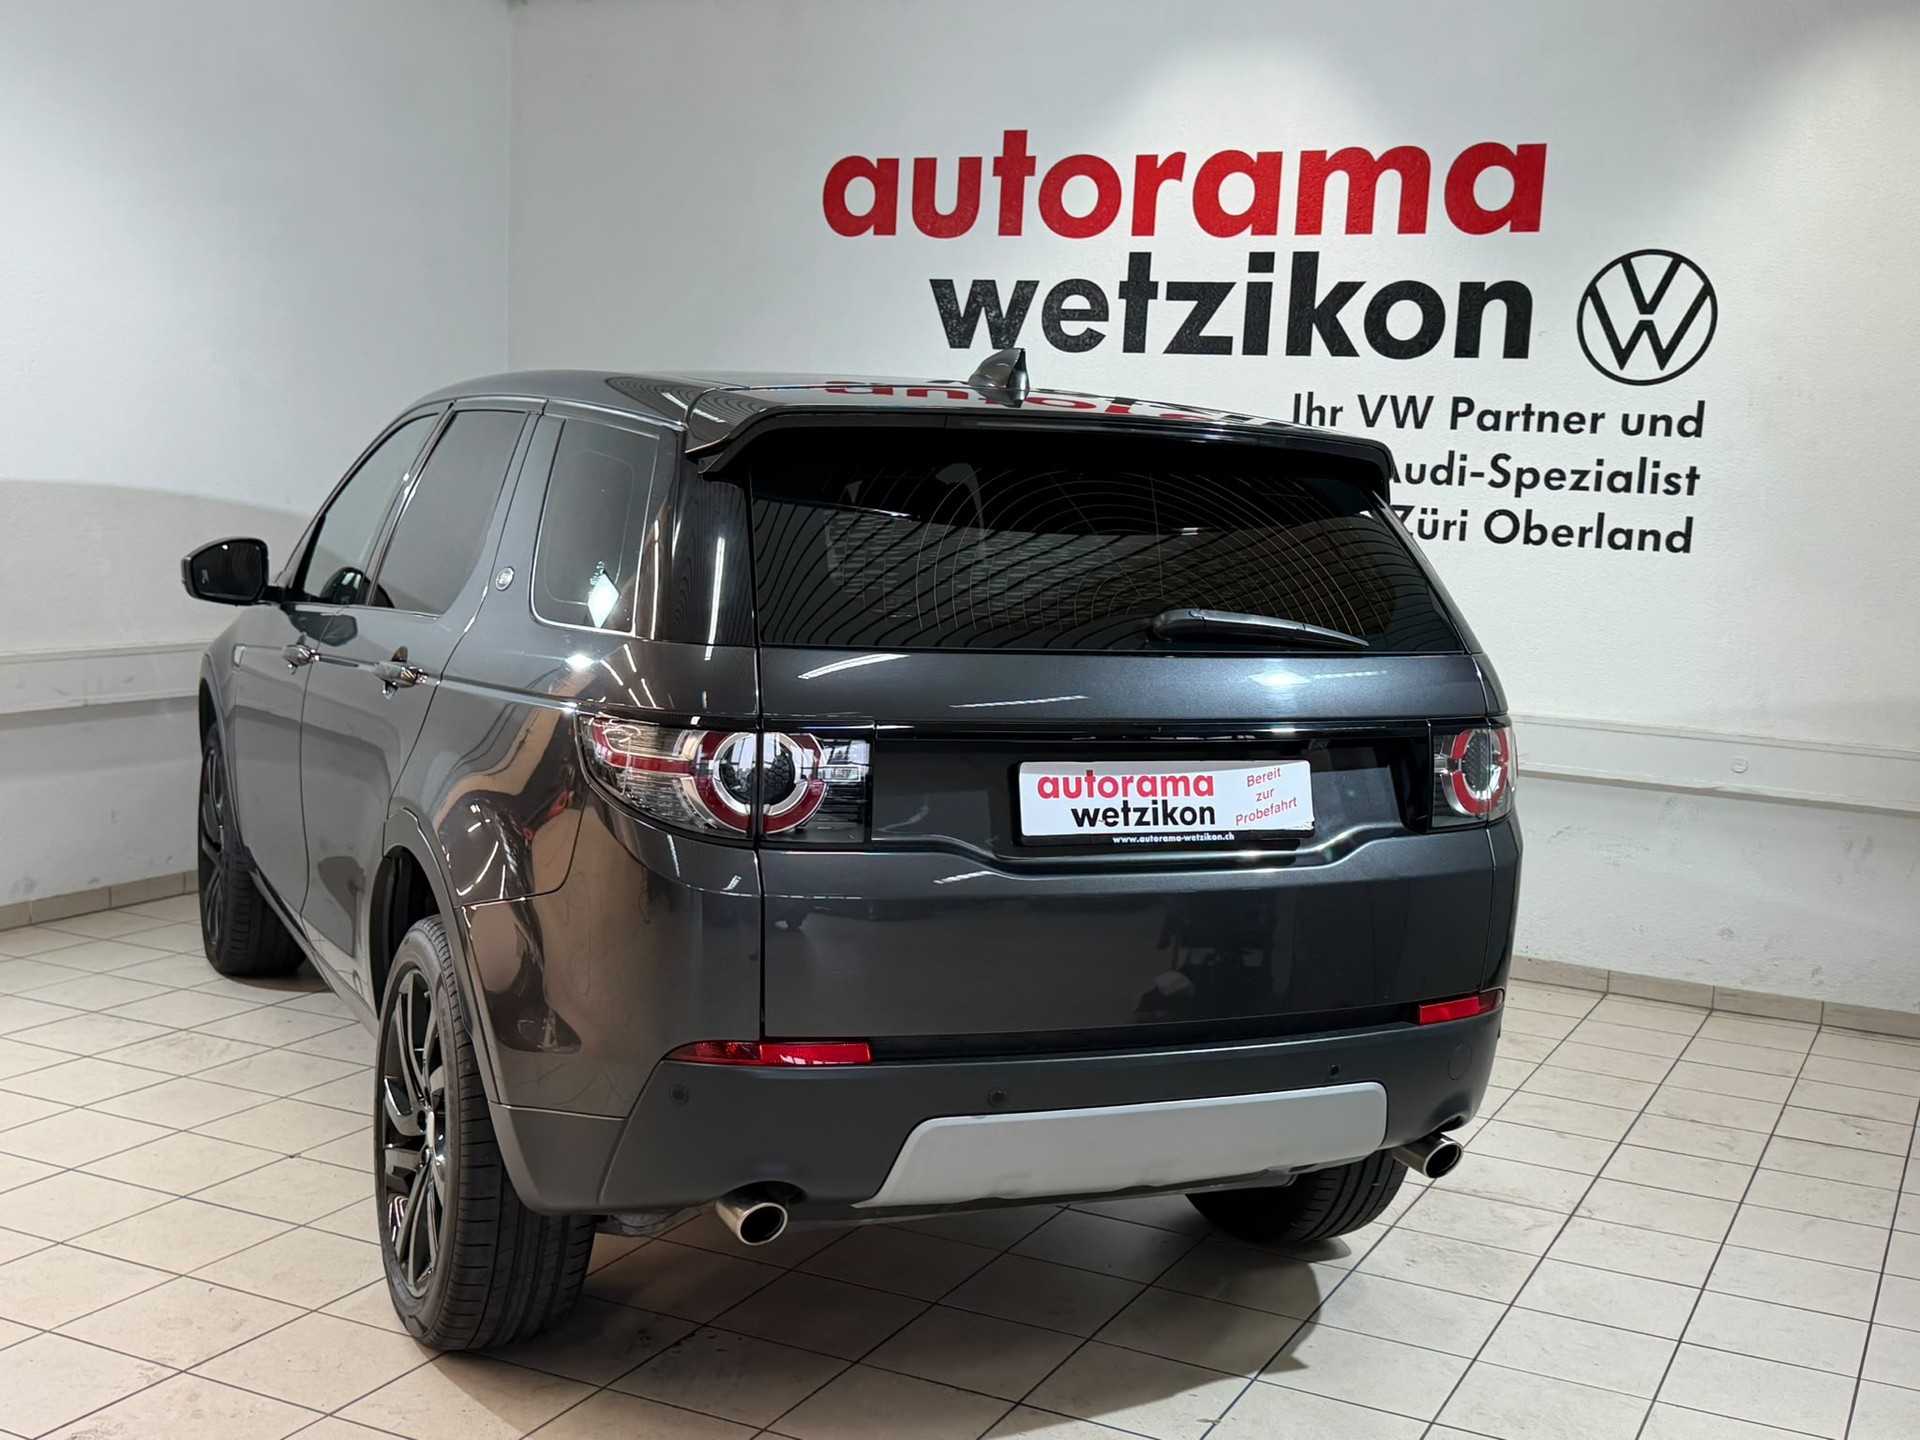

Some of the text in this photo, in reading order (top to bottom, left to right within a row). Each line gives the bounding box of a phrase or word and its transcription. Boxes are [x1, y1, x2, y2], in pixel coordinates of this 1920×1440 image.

[823, 131, 1546, 238] autorama
[929, 252, 1533, 359] wetzikon
[1293, 391, 1706, 438] Ihr VW Partner und
[1483, 508, 1694, 554] Oberland
[1037, 769, 1215, 799] autorama
[1246, 766, 1282, 788] Bereit
[1256, 788, 1275, 802] zur
[1070, 799, 1216, 828] wetzikon
[1235, 796, 1298, 827] Probefahrt
[1112, 832, 1235, 844] www.autorama-wetzikon.ch
